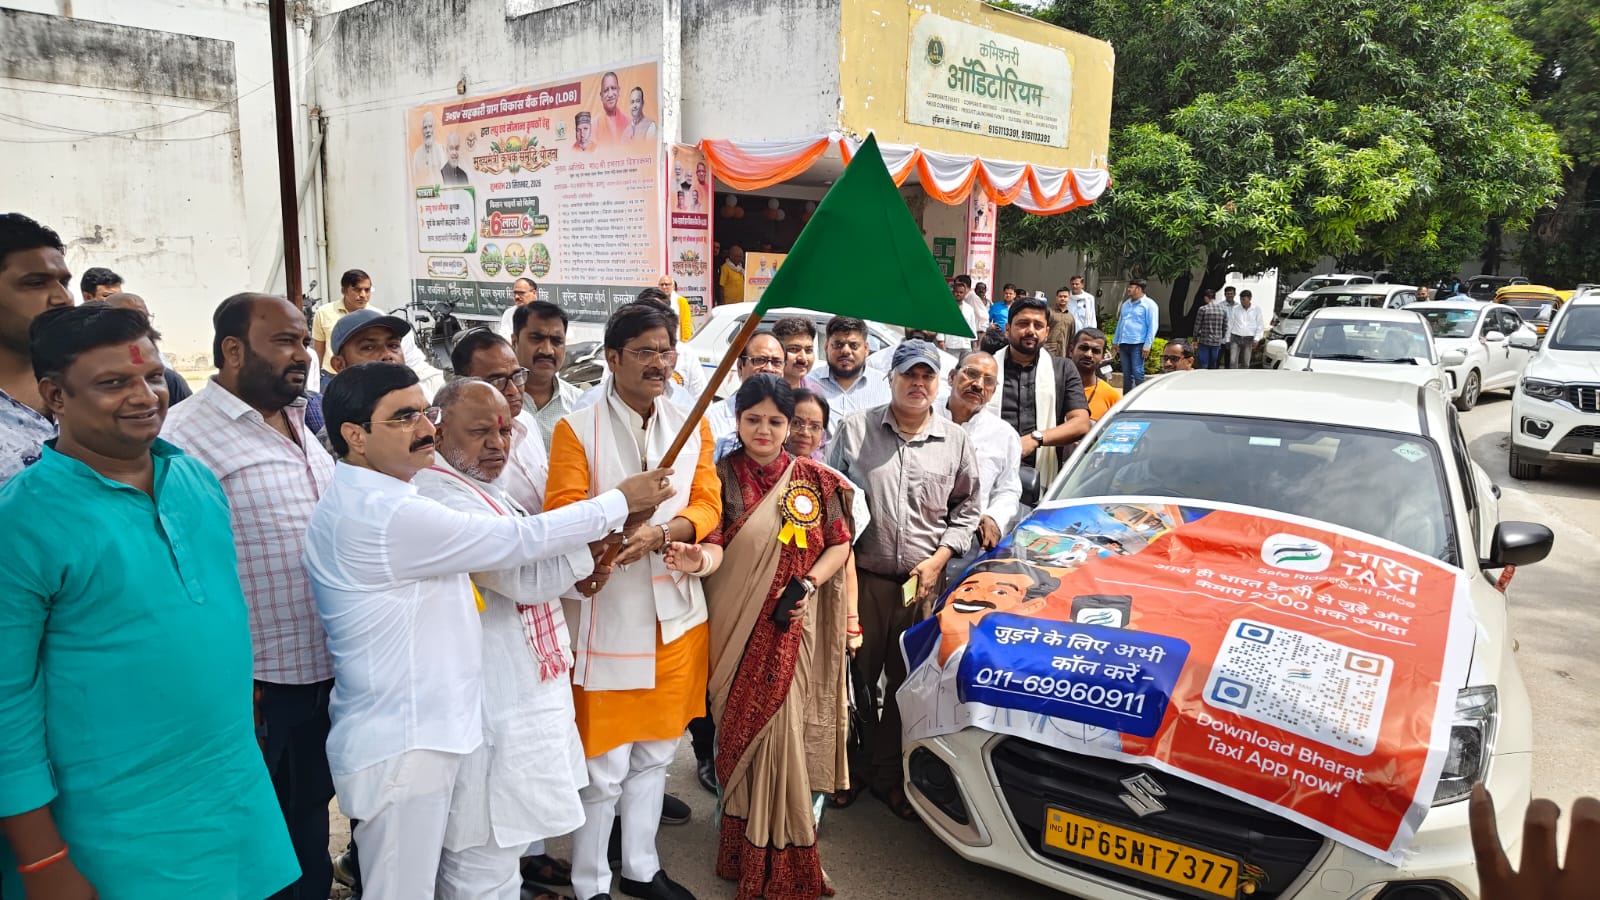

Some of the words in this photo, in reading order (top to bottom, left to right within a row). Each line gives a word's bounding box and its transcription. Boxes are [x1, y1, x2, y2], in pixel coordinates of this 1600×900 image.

[979, 40, 1020, 66] कमिश्नरी
[947, 57, 1044, 107] ऑडिटोरियम
[462, 102, 486, 120] सहकारी
[486, 103, 499, 115] ग्राम
[500, 98, 524, 113] विकास
[525, 94, 539, 109] बैंक
[555, 89, 577, 105] (LDB)
[500, 152, 518, 167] कृषक
[491, 212, 502, 236] 6
[501, 217, 518, 229] लाख
[578, 291, 593, 307] कुमार
[1341, 563, 1417, 596] TAXI
[1343, 550, 1424, 585] भारत
[1153, 563, 1192, 575] आज
[1196, 567, 1215, 579] ही
[1219, 573, 1264, 589] भारत
[1316, 592, 1334, 606] से
[1373, 610, 1413, 625] और
[1257, 567, 1291, 578] Safe
[1376, 590, 1416, 609] Price
[1314, 605, 1349, 621] तक
[1352, 616, 1409, 636] ज्यादा
[994, 626, 1041, 645] जुड़ने
[1042, 630, 1067, 647] के
[1067, 633, 1111, 655] लिए
[1114, 643, 1166, 664] अभी
[1052, 654, 1101, 676] कॉल
[1104, 662, 1141, 684] करें
[975, 667, 1146, 714] 011-69960911
[1196, 712, 1295, 757] Download
[1298, 746, 1365, 785] Bharat
[1206, 735, 1244, 761] Taxi
[1245, 751, 1289, 778] App
[1292, 768, 1343, 798] now!
[1050, 823, 1063, 833] IND
[1065, 821, 1233, 890] UP65NT7377
